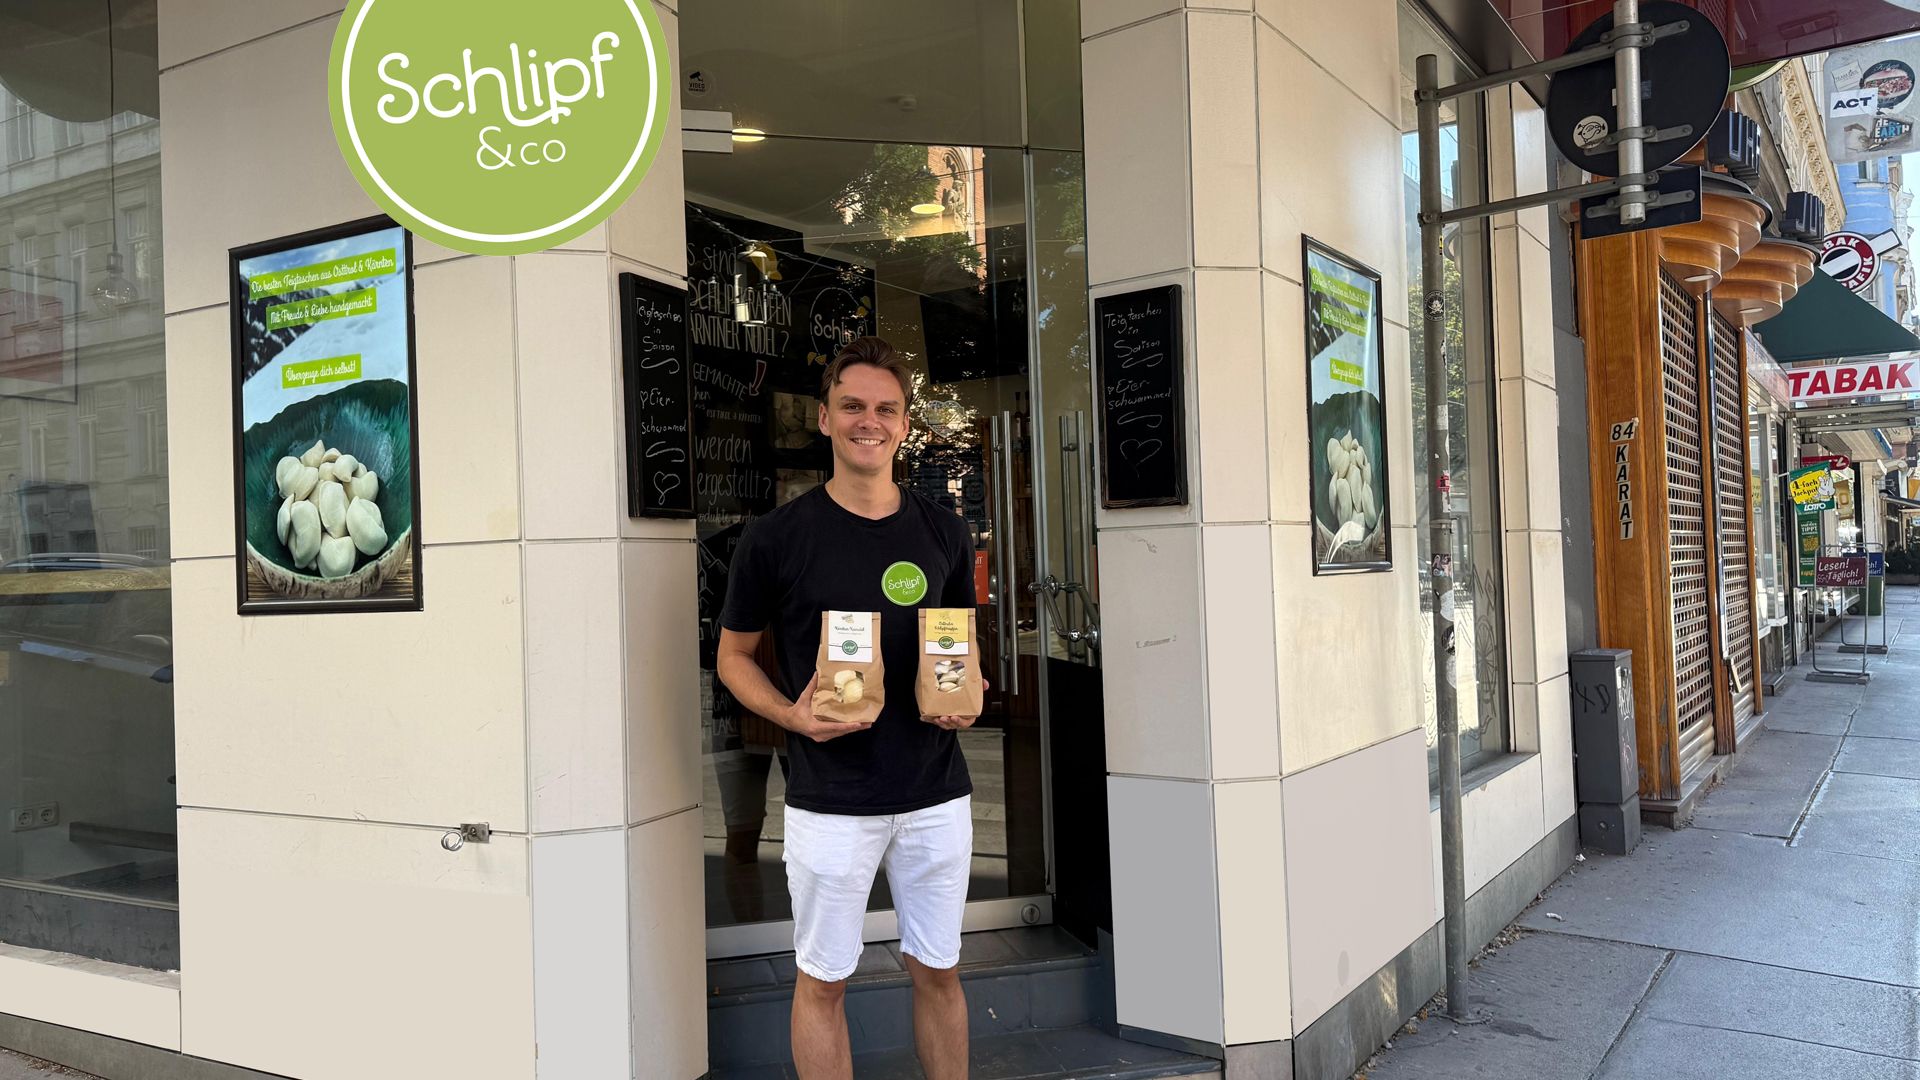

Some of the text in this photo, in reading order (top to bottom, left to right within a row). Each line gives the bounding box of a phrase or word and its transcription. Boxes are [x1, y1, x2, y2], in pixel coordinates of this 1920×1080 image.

[1833, 96, 1873, 111] ACT
[263, 276, 283, 290] besten
[284, 270, 320, 290] Teigtaschen
[365, 257, 394, 271] Kärnten
[281, 308, 304, 322] Freude
[329, 296, 373, 316] handgemacht
[285, 366, 319, 384] Überzeuge
[320, 364, 334, 376] dich
[1787, 362, 1914, 397] TABAK
[1611, 422, 1634, 441] 84
[694, 434, 752, 464] werden
[1615, 444, 1633, 539] KARAT
[1804, 502, 1827, 512] LOTTO
[1818, 558, 1850, 572] Lesen!
[1827, 568, 1859, 583] Täglich!
